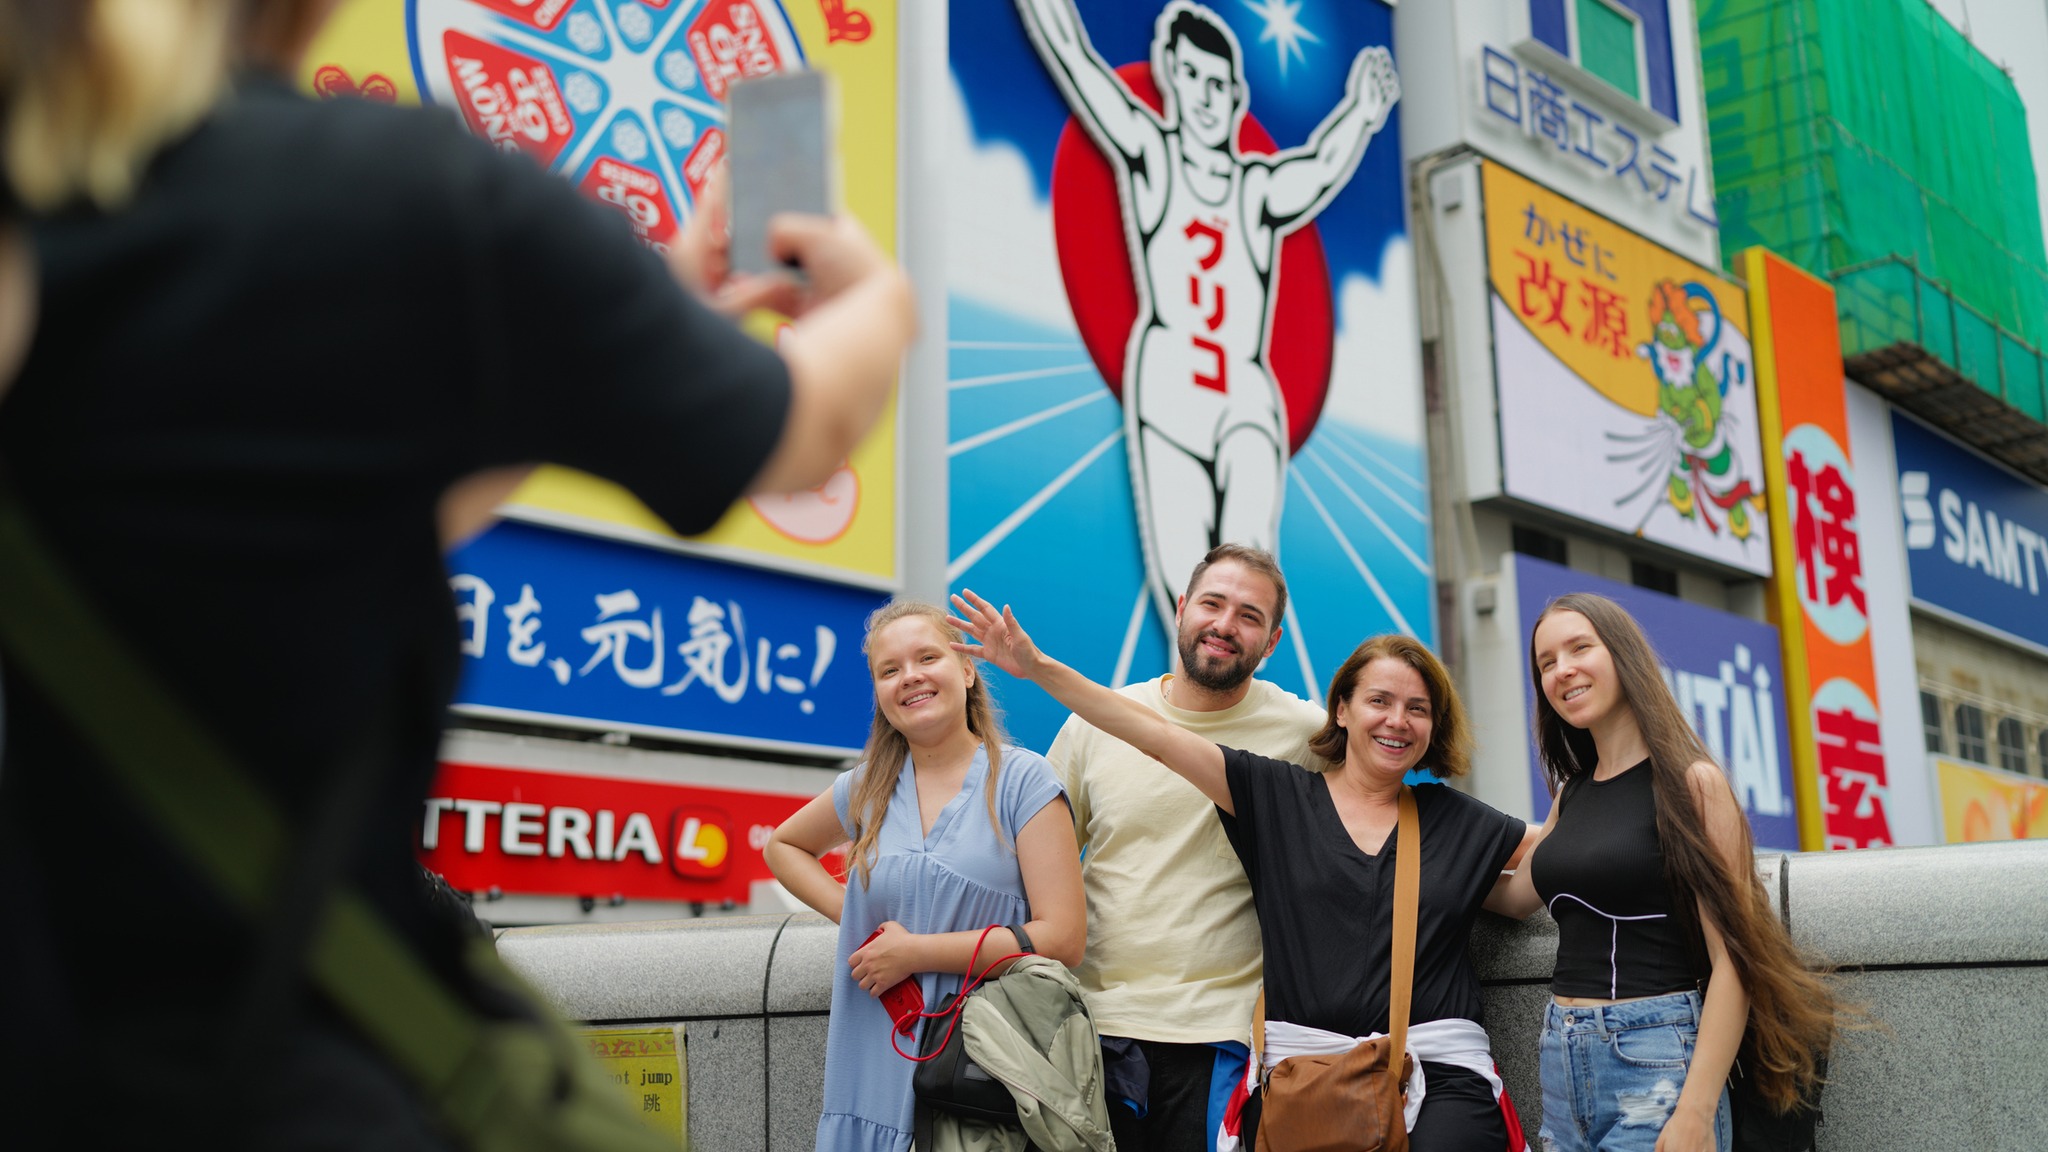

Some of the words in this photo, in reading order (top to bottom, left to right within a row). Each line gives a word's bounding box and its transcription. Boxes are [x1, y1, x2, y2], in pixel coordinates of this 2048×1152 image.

[727, 2, 776, 76] SNO
[507, 67, 549, 143] 6P
[596, 183, 662, 229] 6P
[1521, 202, 1617, 282] かぜに
[1183, 216, 1229, 394] グリコ
[1512, 249, 1631, 358] 改源
[423, 797, 664, 864] TTERIA
[640, 1069, 673, 1086] jump
[643, 1093, 661, 1112] 跳
